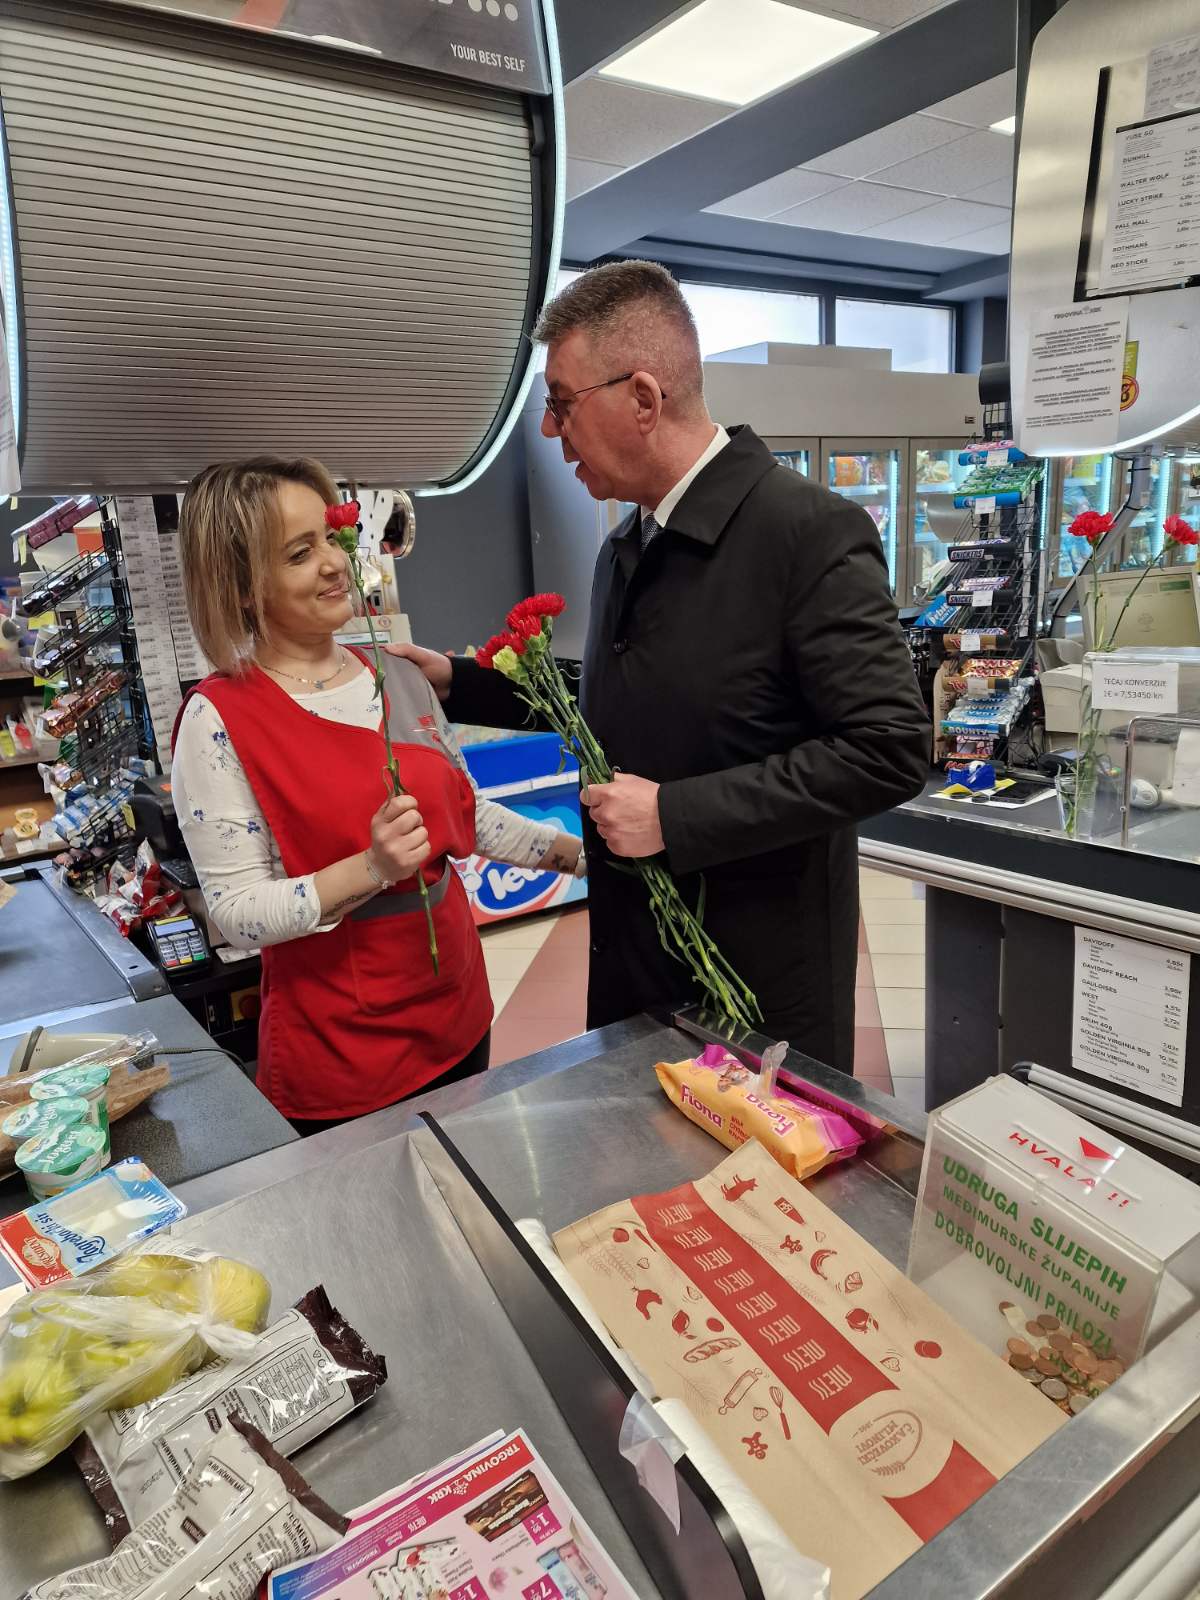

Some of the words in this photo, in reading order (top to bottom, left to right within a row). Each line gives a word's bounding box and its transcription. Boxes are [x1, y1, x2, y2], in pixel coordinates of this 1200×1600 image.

[450, 43, 477, 61] YOUR
[479, 50, 501, 67] BEST
[503, 55, 525, 71] SELF
[1122, 153, 1150, 163] DUNHILL
[1121, 178, 1148, 187] WALTER
[1149, 173, 1169, 181] WOLF
[1118, 198, 1139, 207] LUCKY
[1140, 193, 1163, 202] STRIKE
[1112, 241, 1148, 252] ROTHMANS
[1126, 258, 1148, 267] STICKS
[951, 549, 984, 560] SNICKERS
[948, 725, 987, 735] BOUNTY
[1083, 937, 1114, 948] DAVIDOFF
[1082, 962, 1113, 974] DAVIDOFF
[1115, 972, 1138, 982] REACH
[1082, 979, 1117, 993] GAULOISES
[1082, 992, 1099, 1000] WEST
[1081, 1016, 1099, 1025] DRUM
[1080, 1028, 1106, 1040] GOLDEN
[1107, 1037, 1136, 1050] VIRGINIA
[1080, 1044, 1105, 1057] GOLDEN
[1107, 1053, 1135, 1067] VIRGINIA
[681, 1084, 722, 1128] Fiona
[745, 1093, 796, 1136] Fiona
[1008, 1131, 1096, 1188] HVALA
[35, 1212, 52, 1223] sir
[943, 1156, 1019, 1221] UDRUGA
[1030, 1217, 1128, 1294] SLIJEPIH
[934, 1211, 1041, 1302] DOBROVOLJNI
[1044, 1292, 1114, 1355] PRILOZI
[1040, 1254, 1121, 1321] ŽUPANIJE
[856, 1420, 898, 1453] MLINOVI
[858, 1423, 915, 1466] ČAKOVEČKI
[463, 1443, 520, 1482] TRGOVINA
[427, 1485, 453, 1505] KRK
